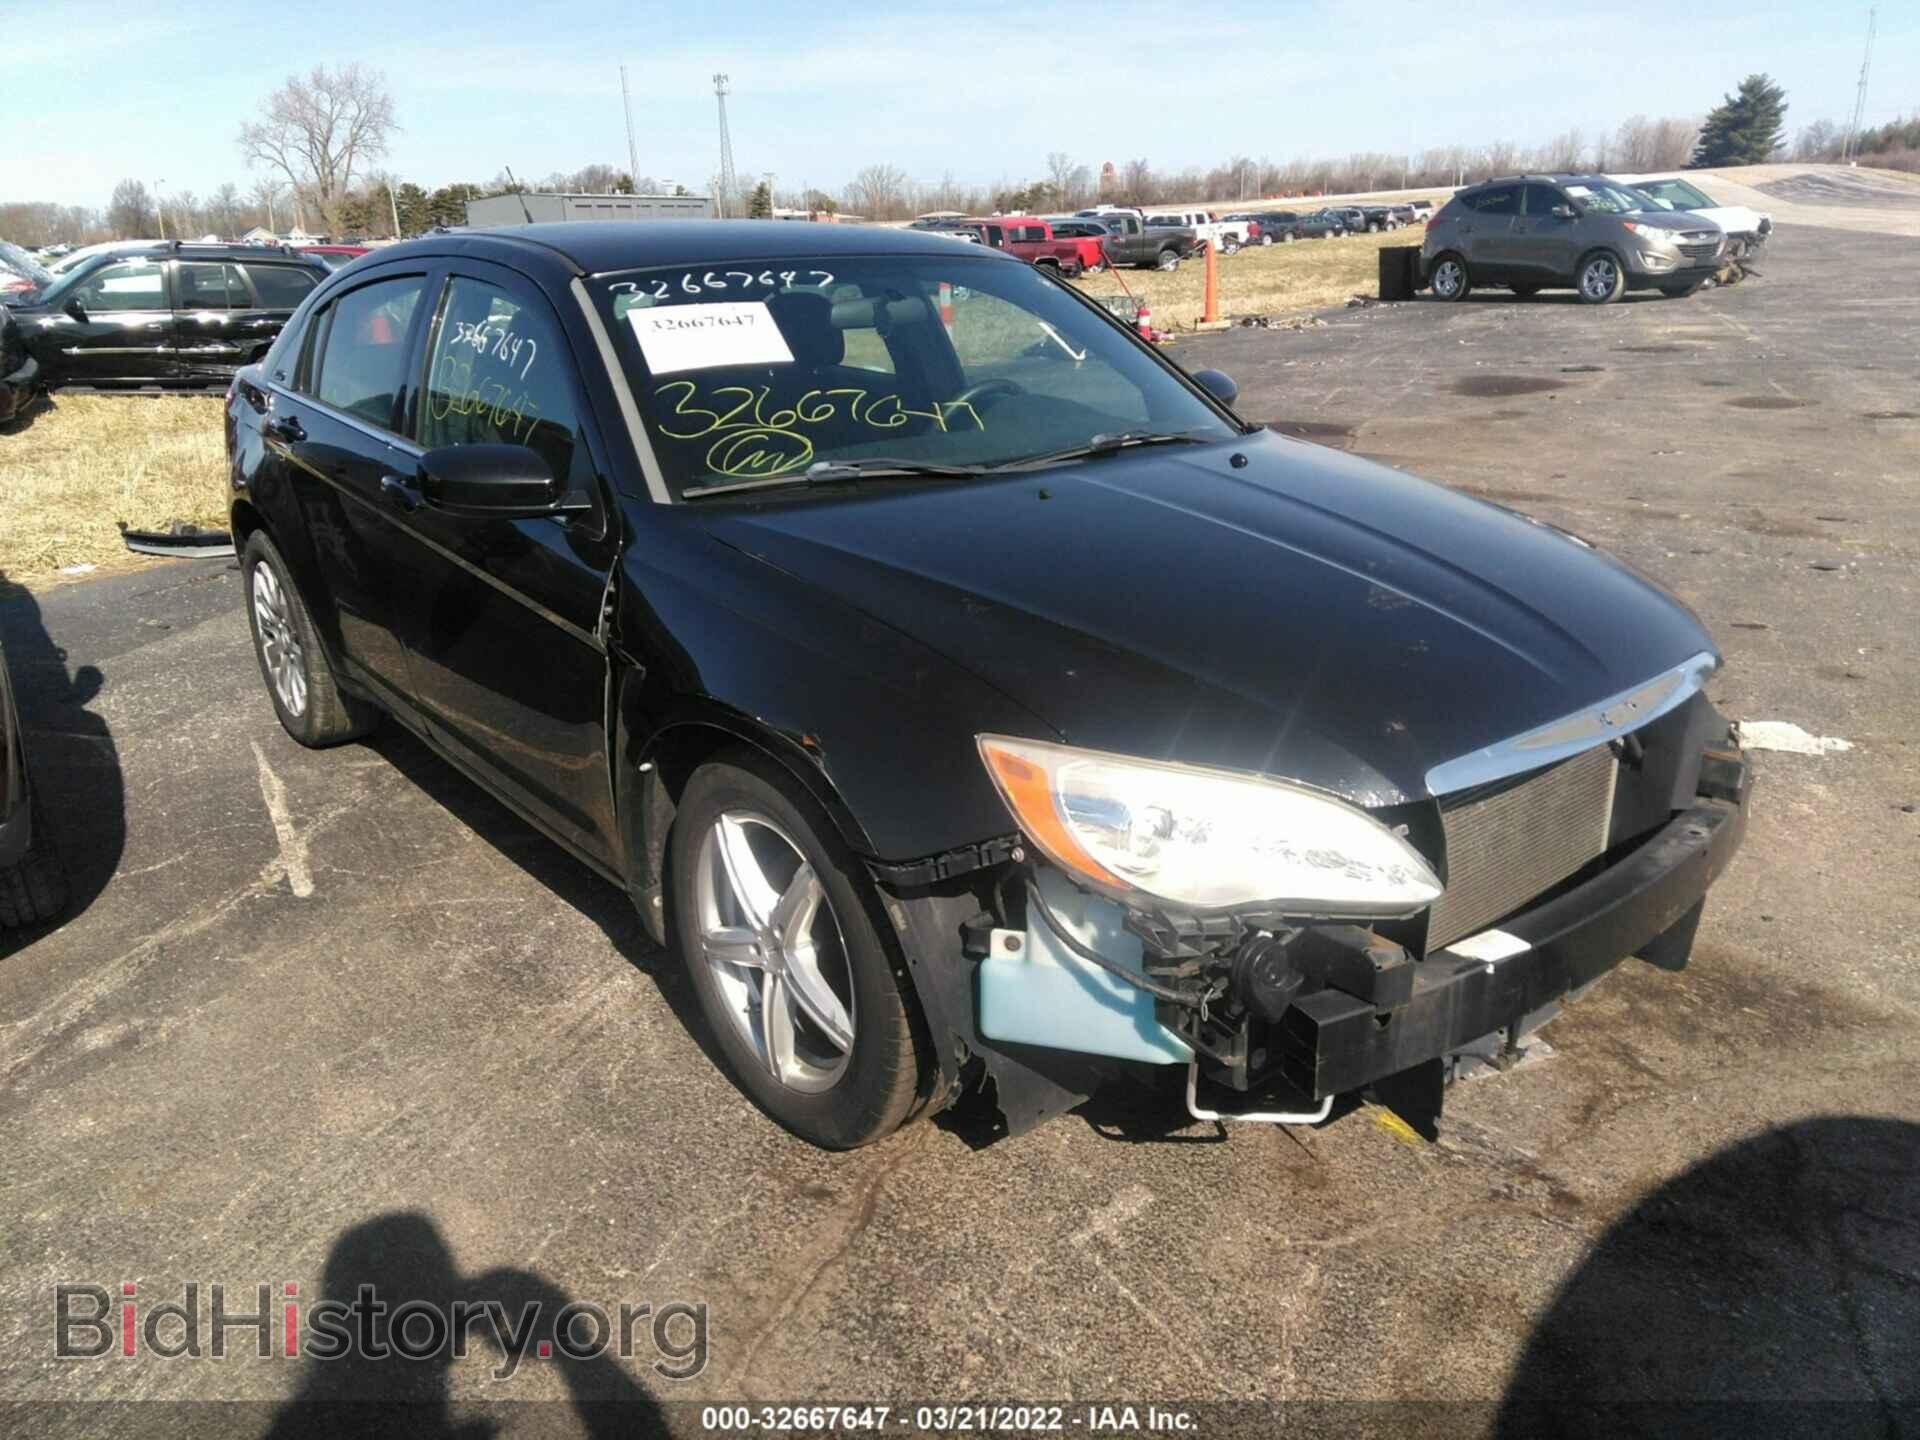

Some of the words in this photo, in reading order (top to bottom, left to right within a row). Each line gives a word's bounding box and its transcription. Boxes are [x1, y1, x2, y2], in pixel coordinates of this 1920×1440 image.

[608, 270, 835, 303] 32667647
[650, 313, 755, 333] 32667647
[655, 381, 985, 439] 32667647
